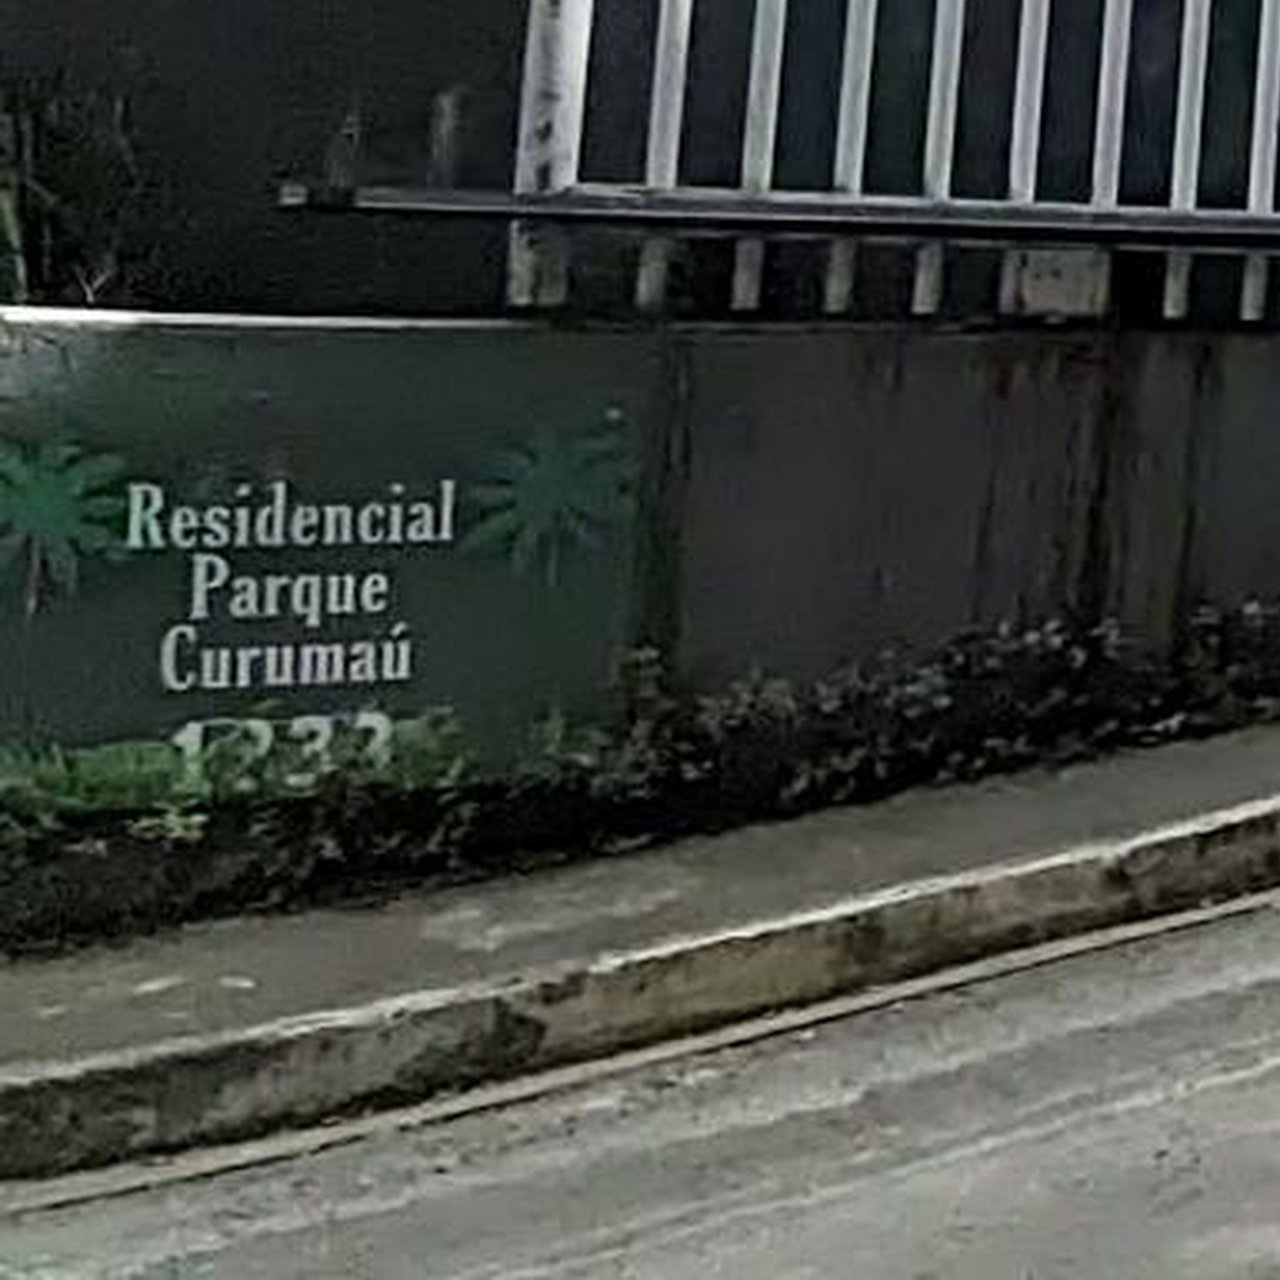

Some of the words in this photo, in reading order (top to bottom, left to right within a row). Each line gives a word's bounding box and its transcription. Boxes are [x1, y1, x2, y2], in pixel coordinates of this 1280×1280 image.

[126, 480, 455, 550] Residencial
[190, 553, 389, 627] Parque
[160, 622, 413, 692] Curumaú
